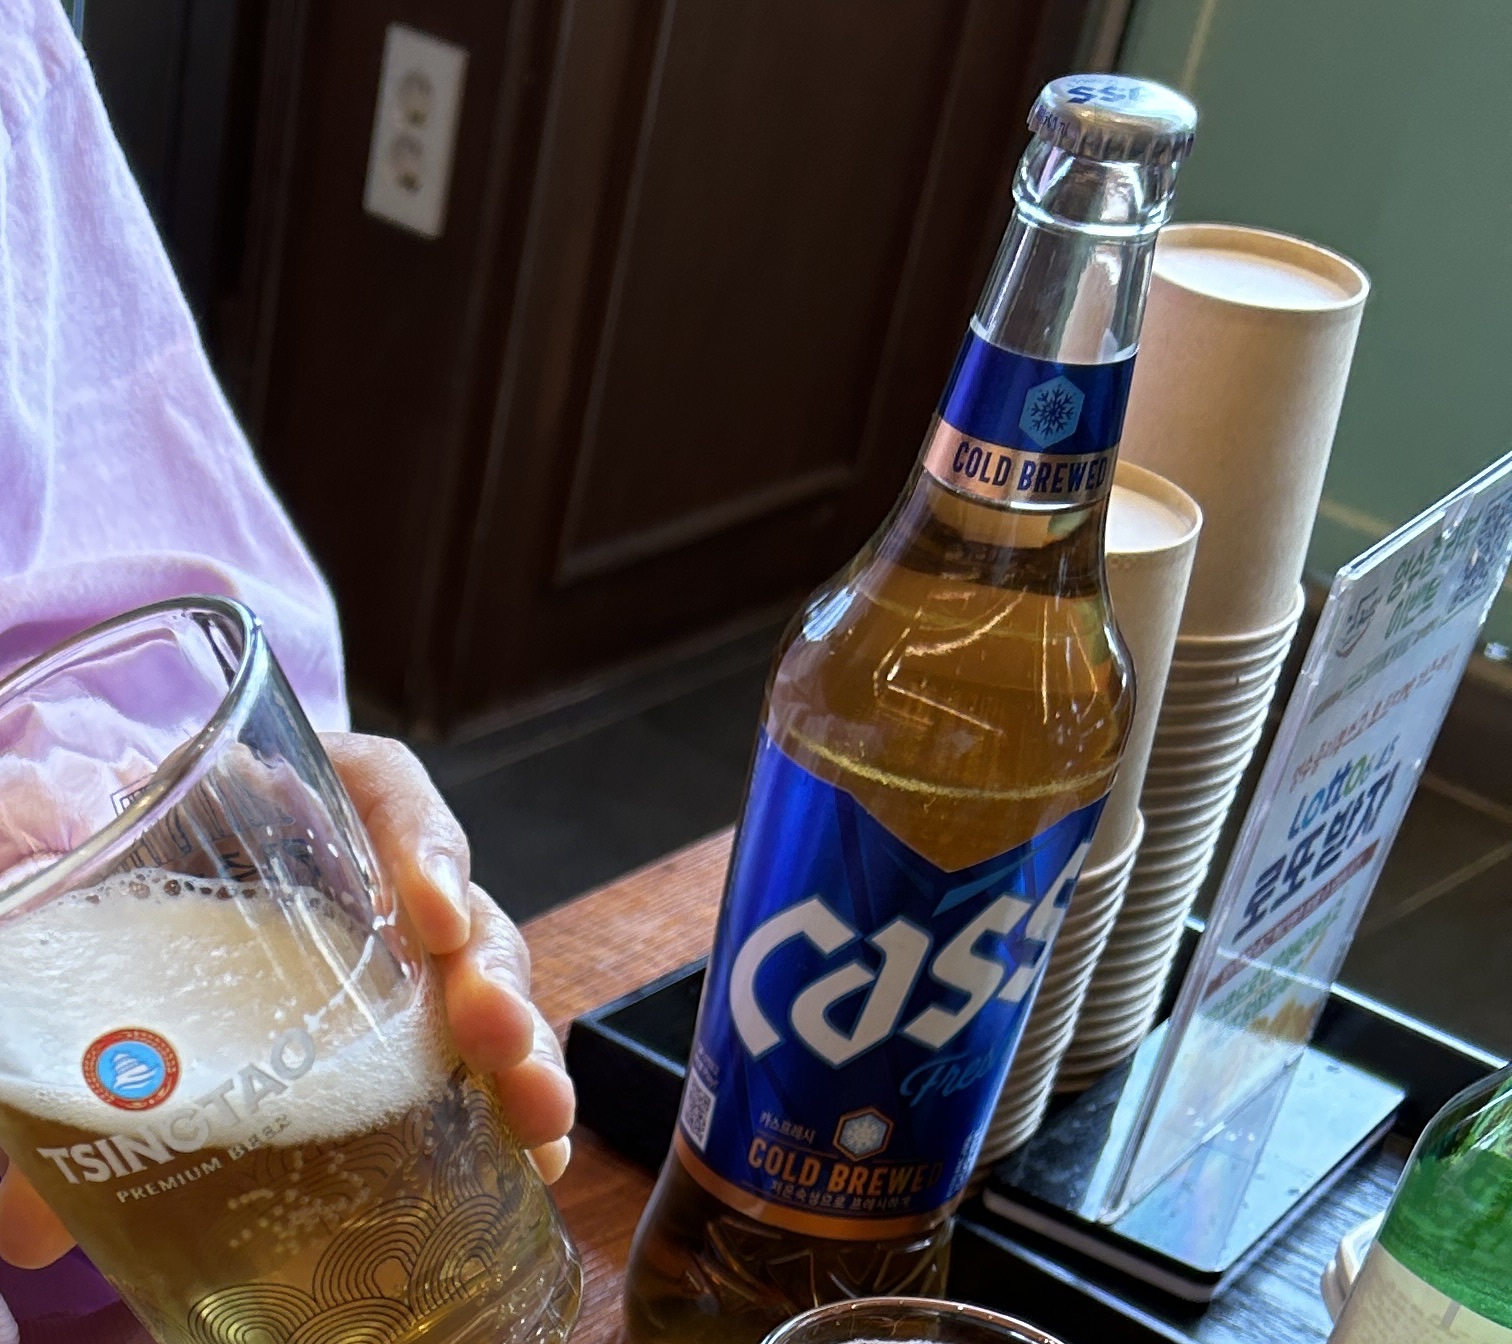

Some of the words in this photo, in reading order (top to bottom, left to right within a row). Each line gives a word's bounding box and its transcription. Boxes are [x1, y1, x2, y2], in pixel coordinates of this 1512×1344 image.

[952, 440, 1013, 487] COLD
[1016, 455, 1109, 494] BREWED
[1231, 759, 1401, 945] 로또받자
[36, 1026, 317, 1186] TSINGTAO
[116, 1157, 224, 1204] PREMIUM
[226, 1113, 291, 1161] BEER
[748, 1136, 822, 1188] COLD
[826, 1160, 945, 1197] BREWED
